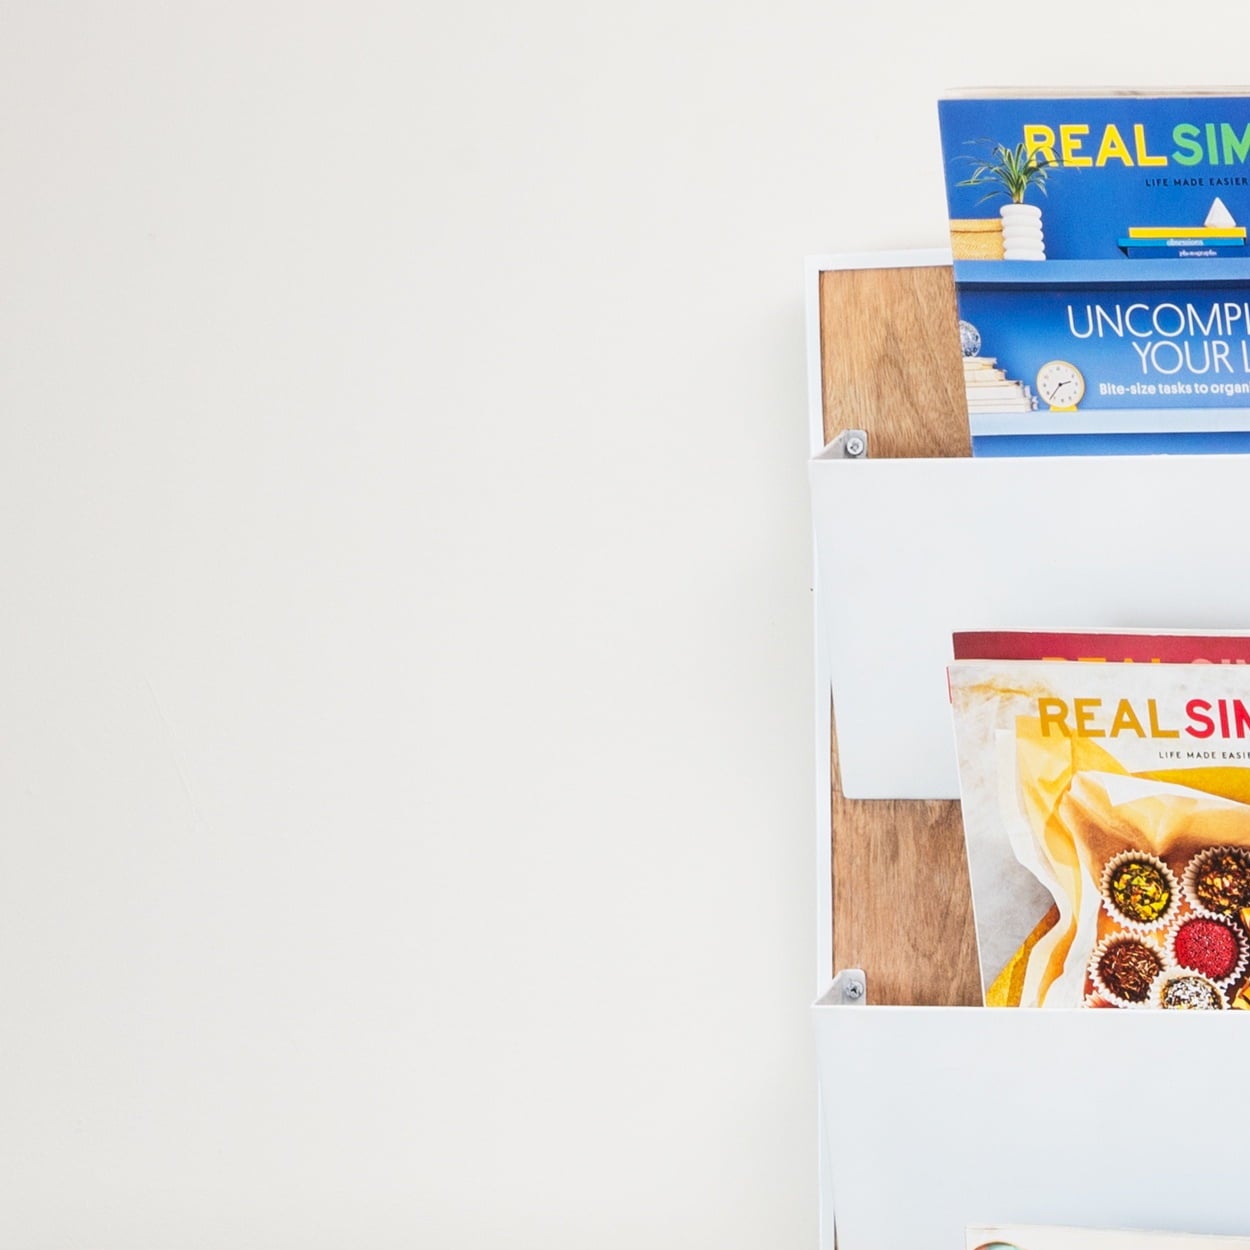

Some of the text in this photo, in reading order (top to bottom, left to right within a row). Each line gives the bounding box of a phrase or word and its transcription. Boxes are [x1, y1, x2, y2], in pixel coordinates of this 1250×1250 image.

[1023, 123, 1168, 168] REAL
[1145, 177, 1249, 187] LIFE MADE EASIER
[1132, 339, 1235, 375] YOUR
[1099, 382, 1157, 395] Bite-size
[1158, 381, 1193, 395] tasks
[1194, 382, 1209, 395] to
[1037, 697, 1180, 739] REAL
[1159, 751, 1181, 760] LIFE
[1186, 751, 1217, 760] MADE
